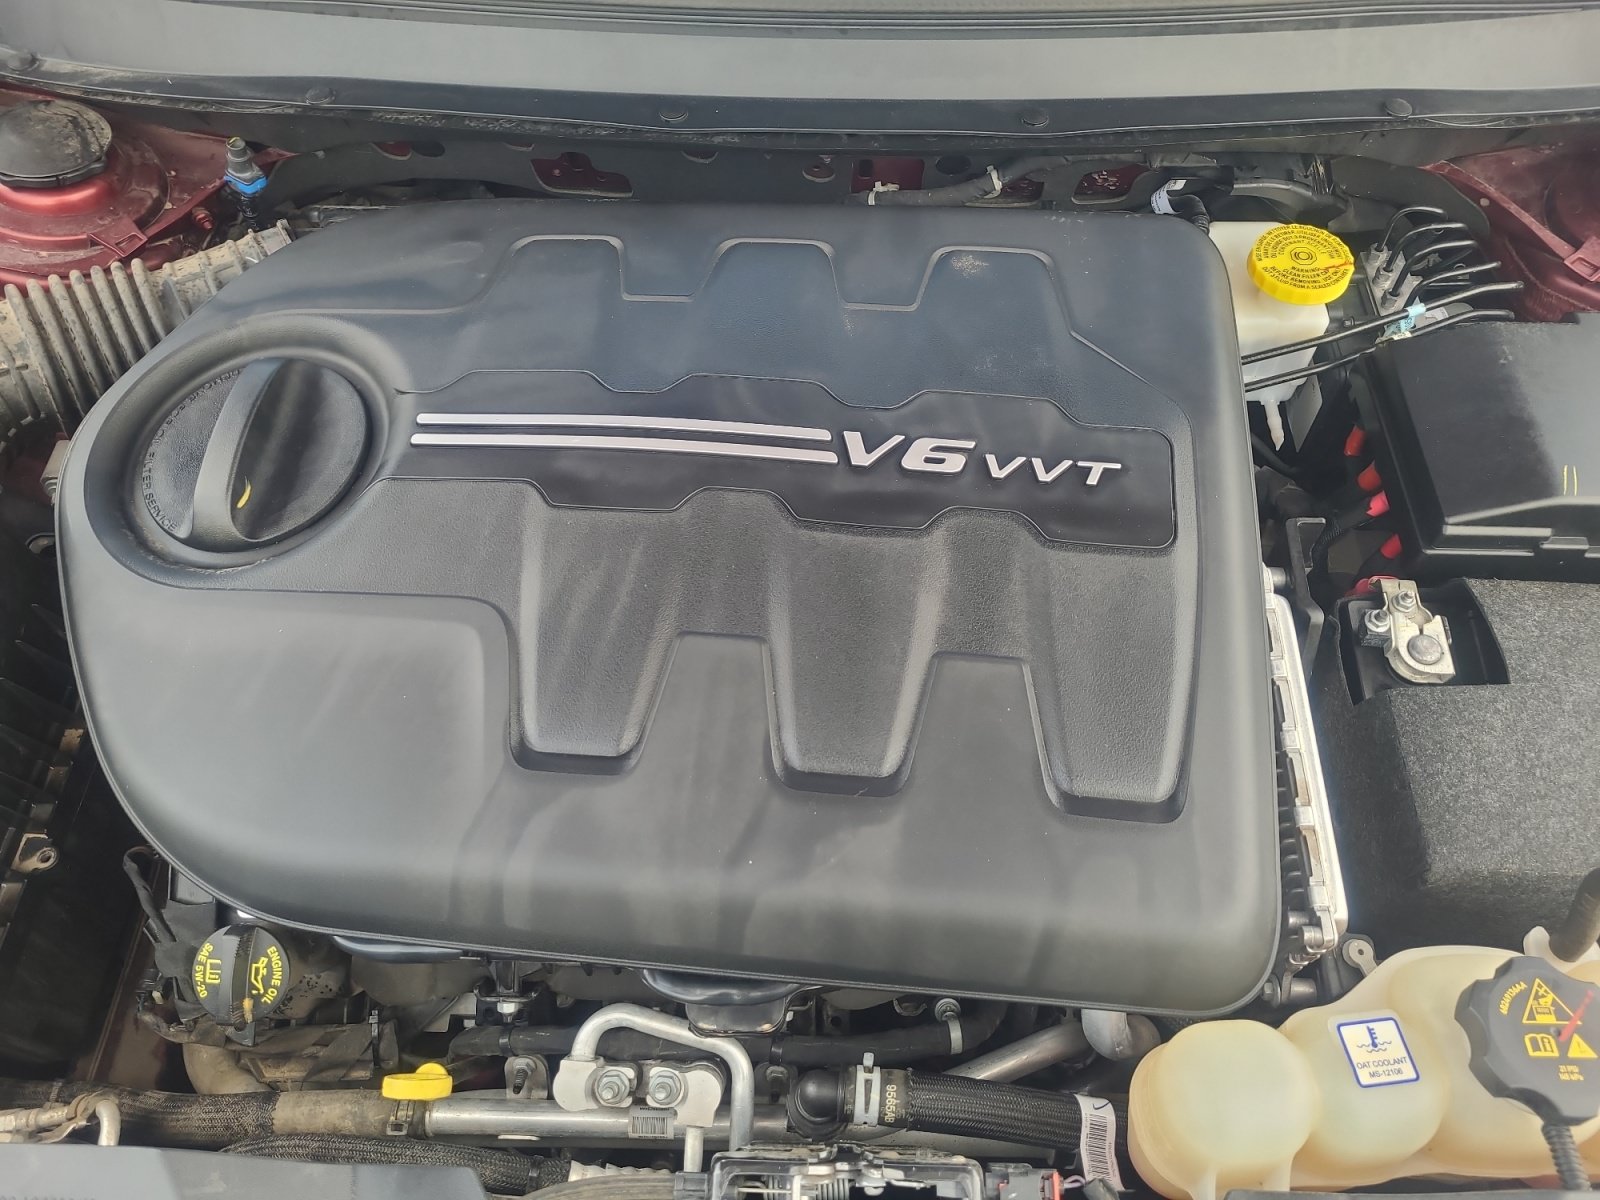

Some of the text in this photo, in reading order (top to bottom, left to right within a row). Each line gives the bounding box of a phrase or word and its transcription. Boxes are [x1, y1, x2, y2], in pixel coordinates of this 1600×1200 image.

[1270, 266, 1289, 280] BEFORE
[1275, 275, 1290, 285] FLUID
[1282, 268, 1300, 278] CLEAN
[843, 430, 1122, 485] V6 VVT
[144, 492, 178, 532] SERVICE
[194, 942, 214, 998] SAE 5W-20
[261, 946, 282, 1004] ENGINE OIL
[1356, 1056, 1407, 1070] OAT COOLANT
[1368, 1068, 1404, 1078] MS-12106
[884, 1084, 897, 1123] 9565AB
